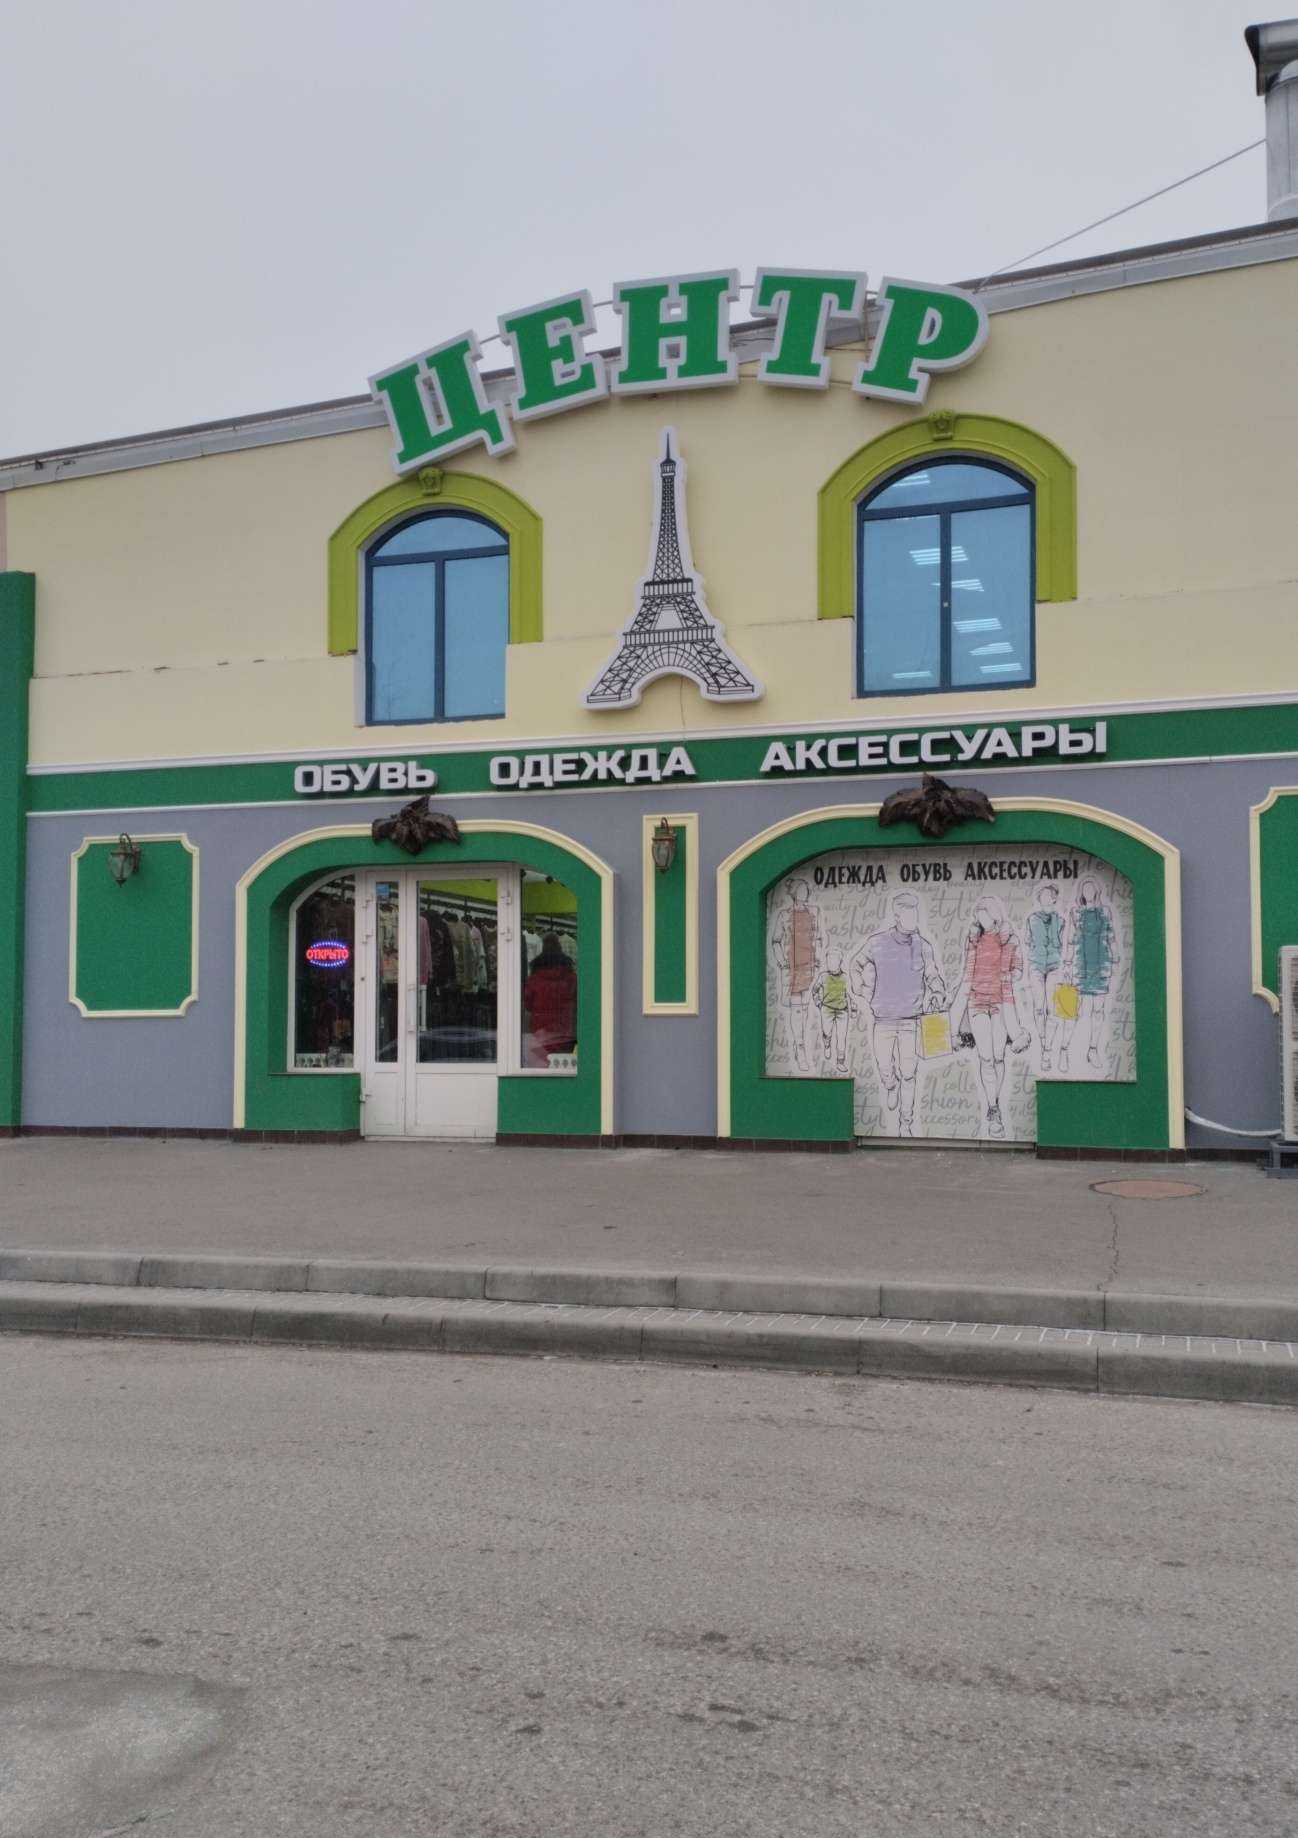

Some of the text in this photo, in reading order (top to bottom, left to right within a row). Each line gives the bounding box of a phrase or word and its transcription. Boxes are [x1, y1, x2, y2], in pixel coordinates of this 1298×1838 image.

[370, 269, 986, 471] ЦЕНТР
[294, 722, 1108, 794] ОБУВЬ ОДЕЖДА АКСЕССУАРЫ
[814, 864, 887, 889] ОДЕЖДА
[900, 863, 952, 883] ОБУВЬ
[964, 859, 1080, 882] АКСЕССУАРЫ
[306, 948, 349, 960] ОТКРЫТО
